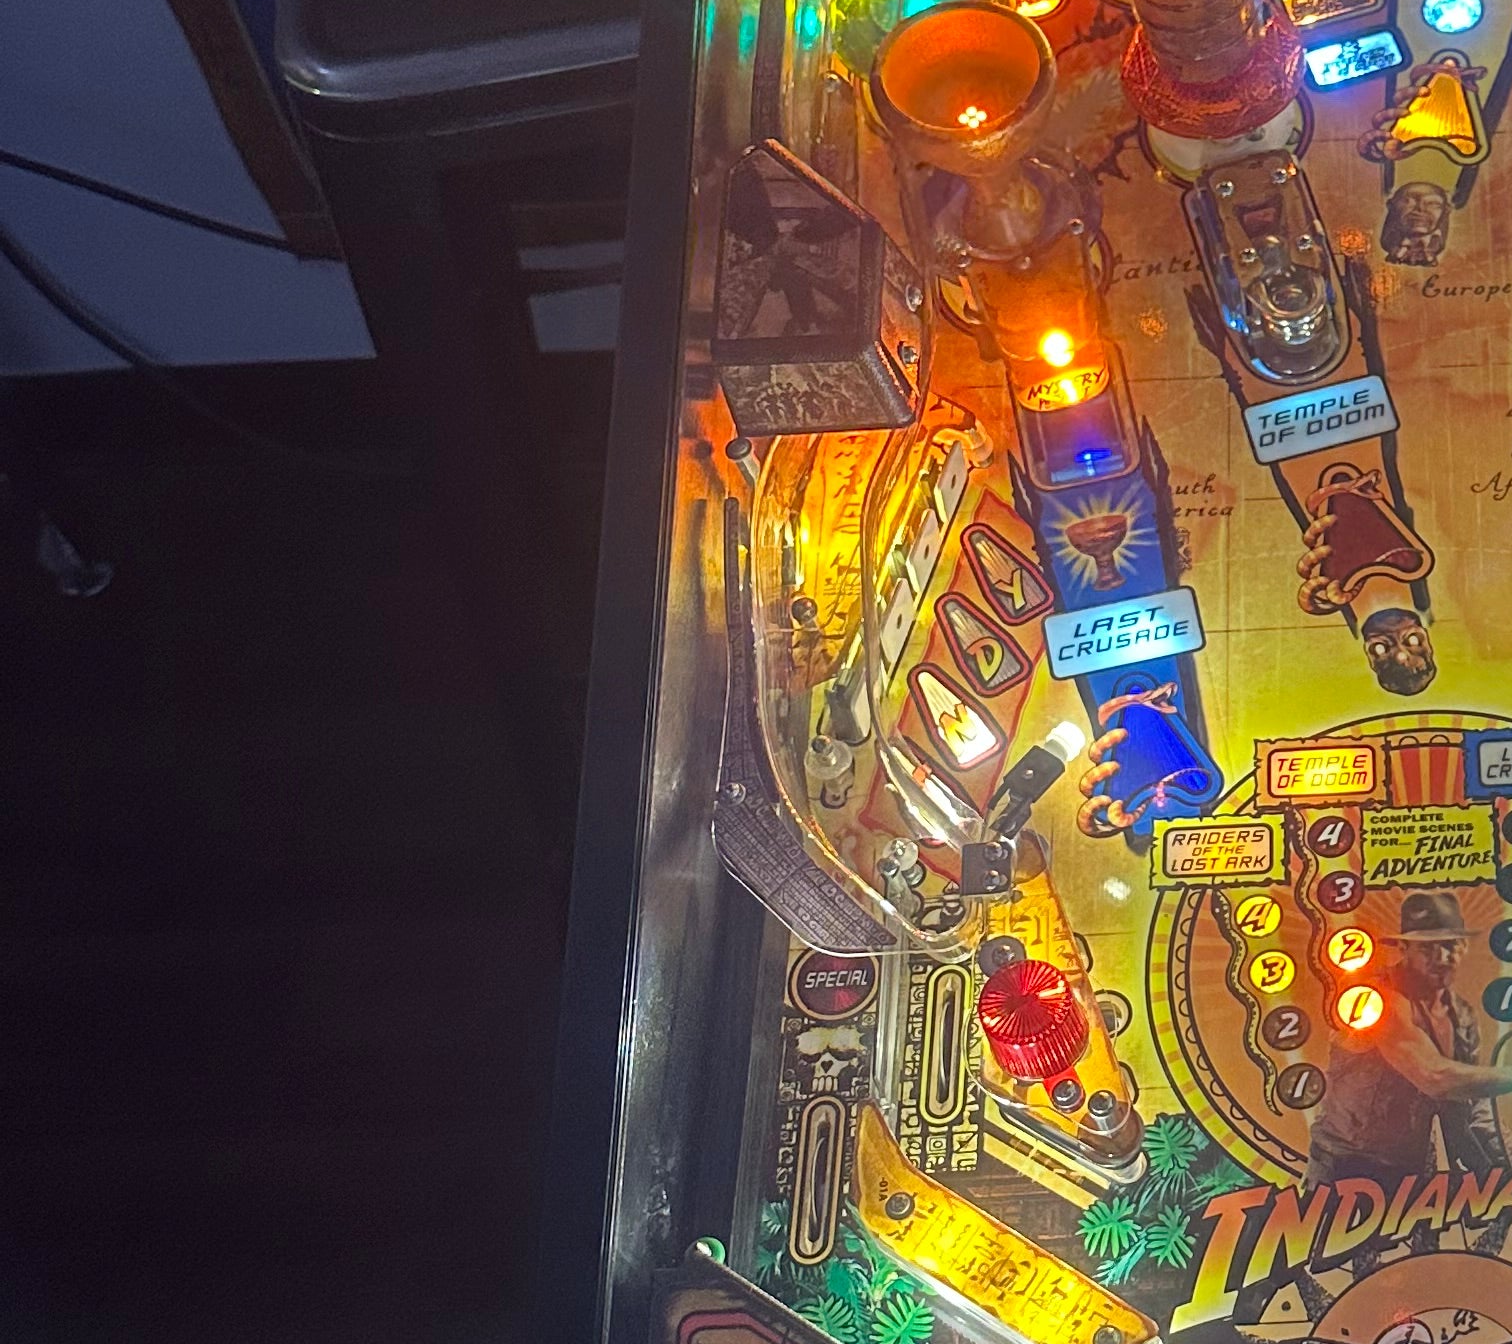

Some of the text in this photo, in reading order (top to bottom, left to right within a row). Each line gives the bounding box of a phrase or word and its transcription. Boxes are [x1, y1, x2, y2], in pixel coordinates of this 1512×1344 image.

[1257, 389, 1372, 429] TEMPLE
[1259, 403, 1387, 449] OF DOOM
[1073, 604, 1166, 637] LAST
[1058, 620, 1190, 662] CRUSADE
[1275, 752, 1369, 774] TEMPLE
[1275, 769, 1370, 790] OF DOOM
[1369, 813, 1444, 825] COMPLETE
[1370, 822, 1474, 835] MOVIE SCENES
[1170, 828, 1266, 847] RAIDERS
[1414, 833, 1475, 856] FINAL
[1191, 844, 1247, 856] OF THE
[1170, 852, 1267, 872] LOST ARK
[1369, 849, 1492, 881] ADVENTURE
[805, 969, 869, 988] SPECIAL
